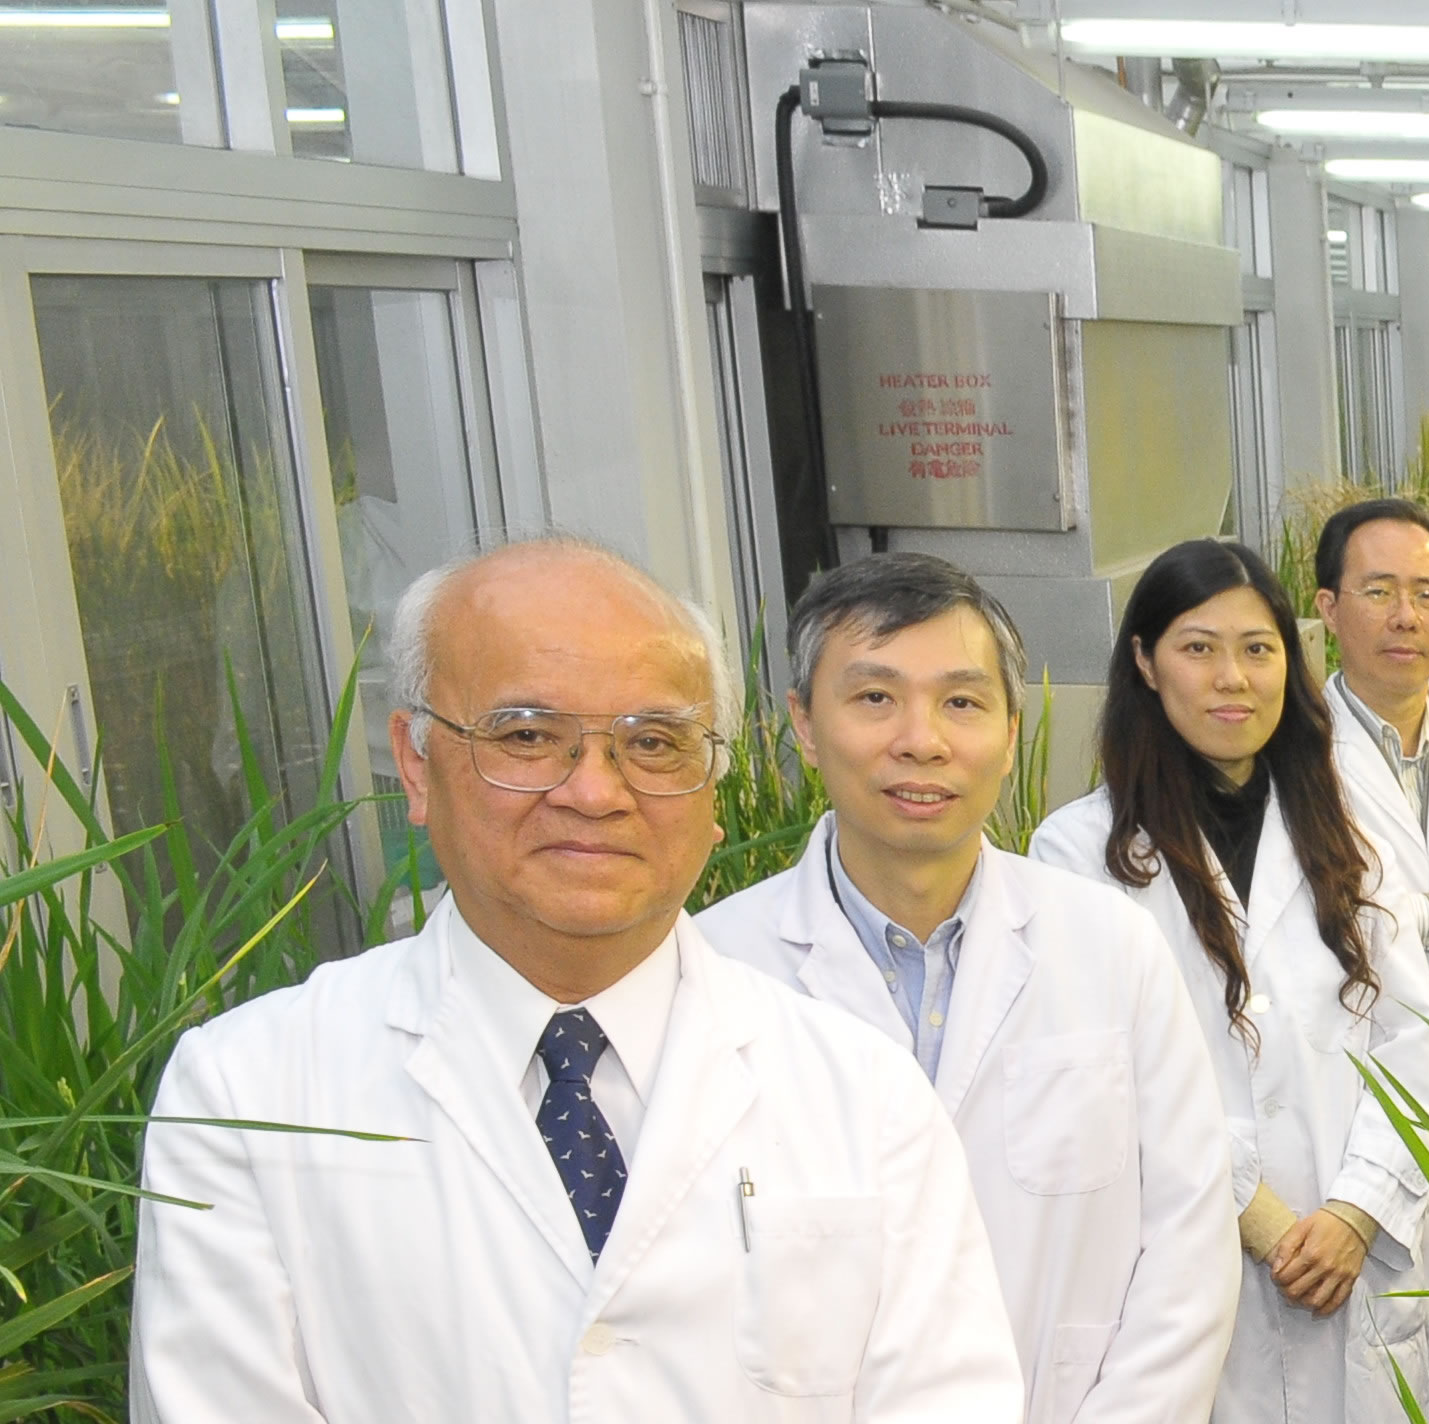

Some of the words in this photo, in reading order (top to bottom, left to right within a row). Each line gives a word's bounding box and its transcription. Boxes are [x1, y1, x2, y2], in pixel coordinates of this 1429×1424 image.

[880, 375, 949, 388] HEATER
[955, 375, 991, 388] BOX
[879, 423, 920, 436] LIVE
[923, 422, 1013, 436] TERMINAL
[912, 443, 984, 456] DANGER
